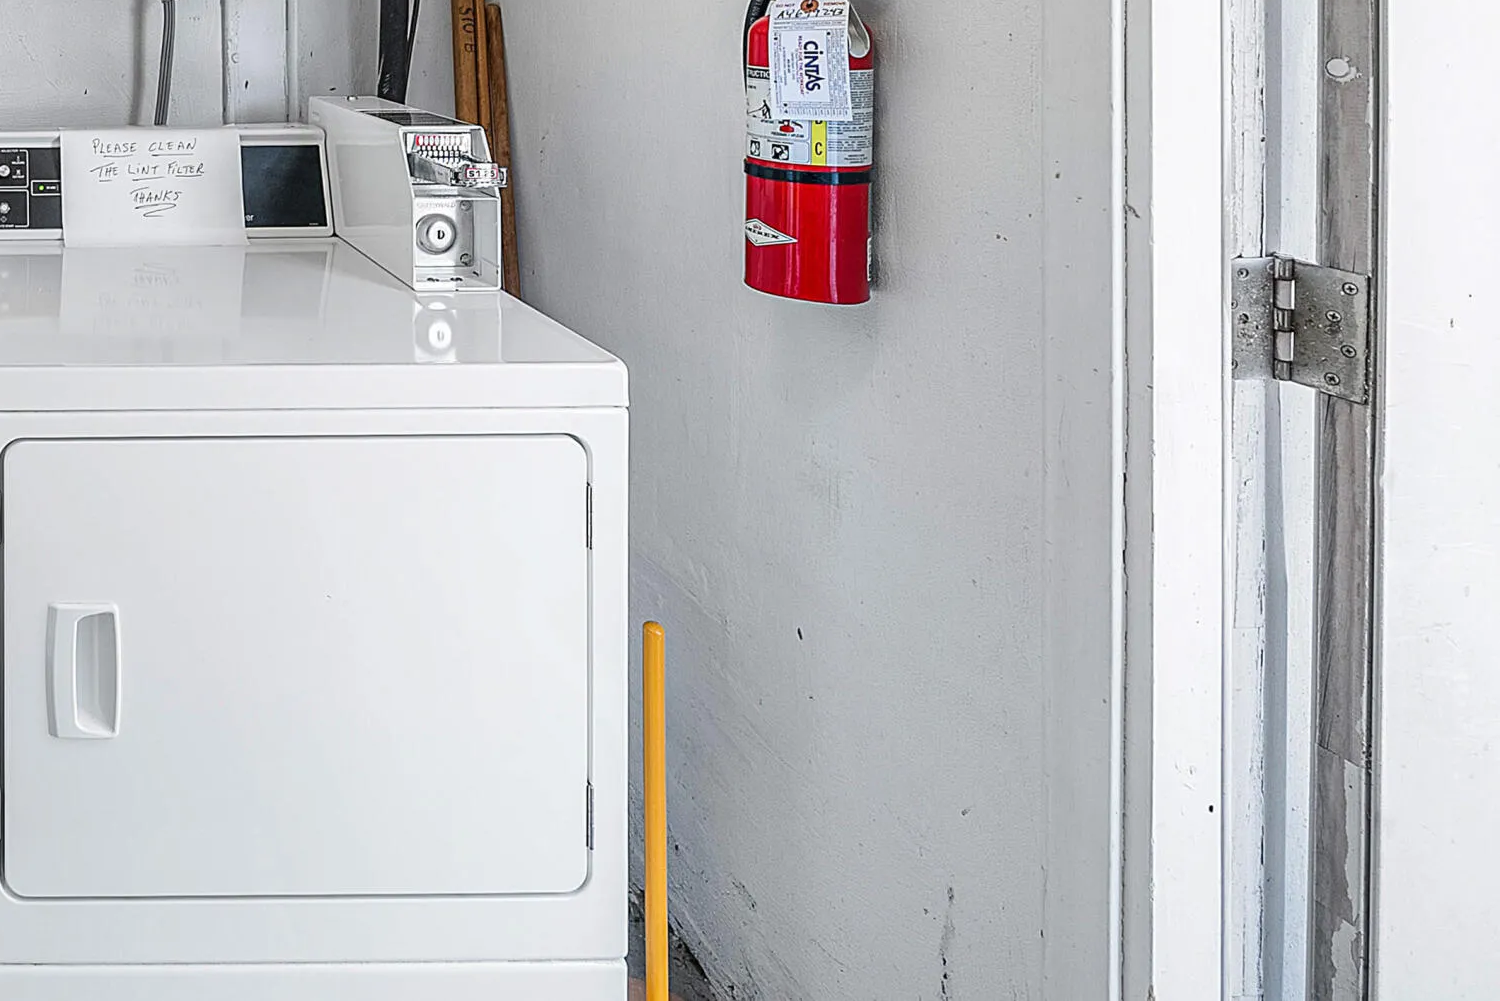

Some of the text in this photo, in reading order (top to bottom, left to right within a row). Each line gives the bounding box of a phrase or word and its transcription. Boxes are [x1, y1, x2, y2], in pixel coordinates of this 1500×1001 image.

[92, 137, 197, 154] PLEASE CLEAN
[814, 142, 823, 156] C
[90, 162, 119, 178] THE
[130, 187, 182, 204] THANKS
